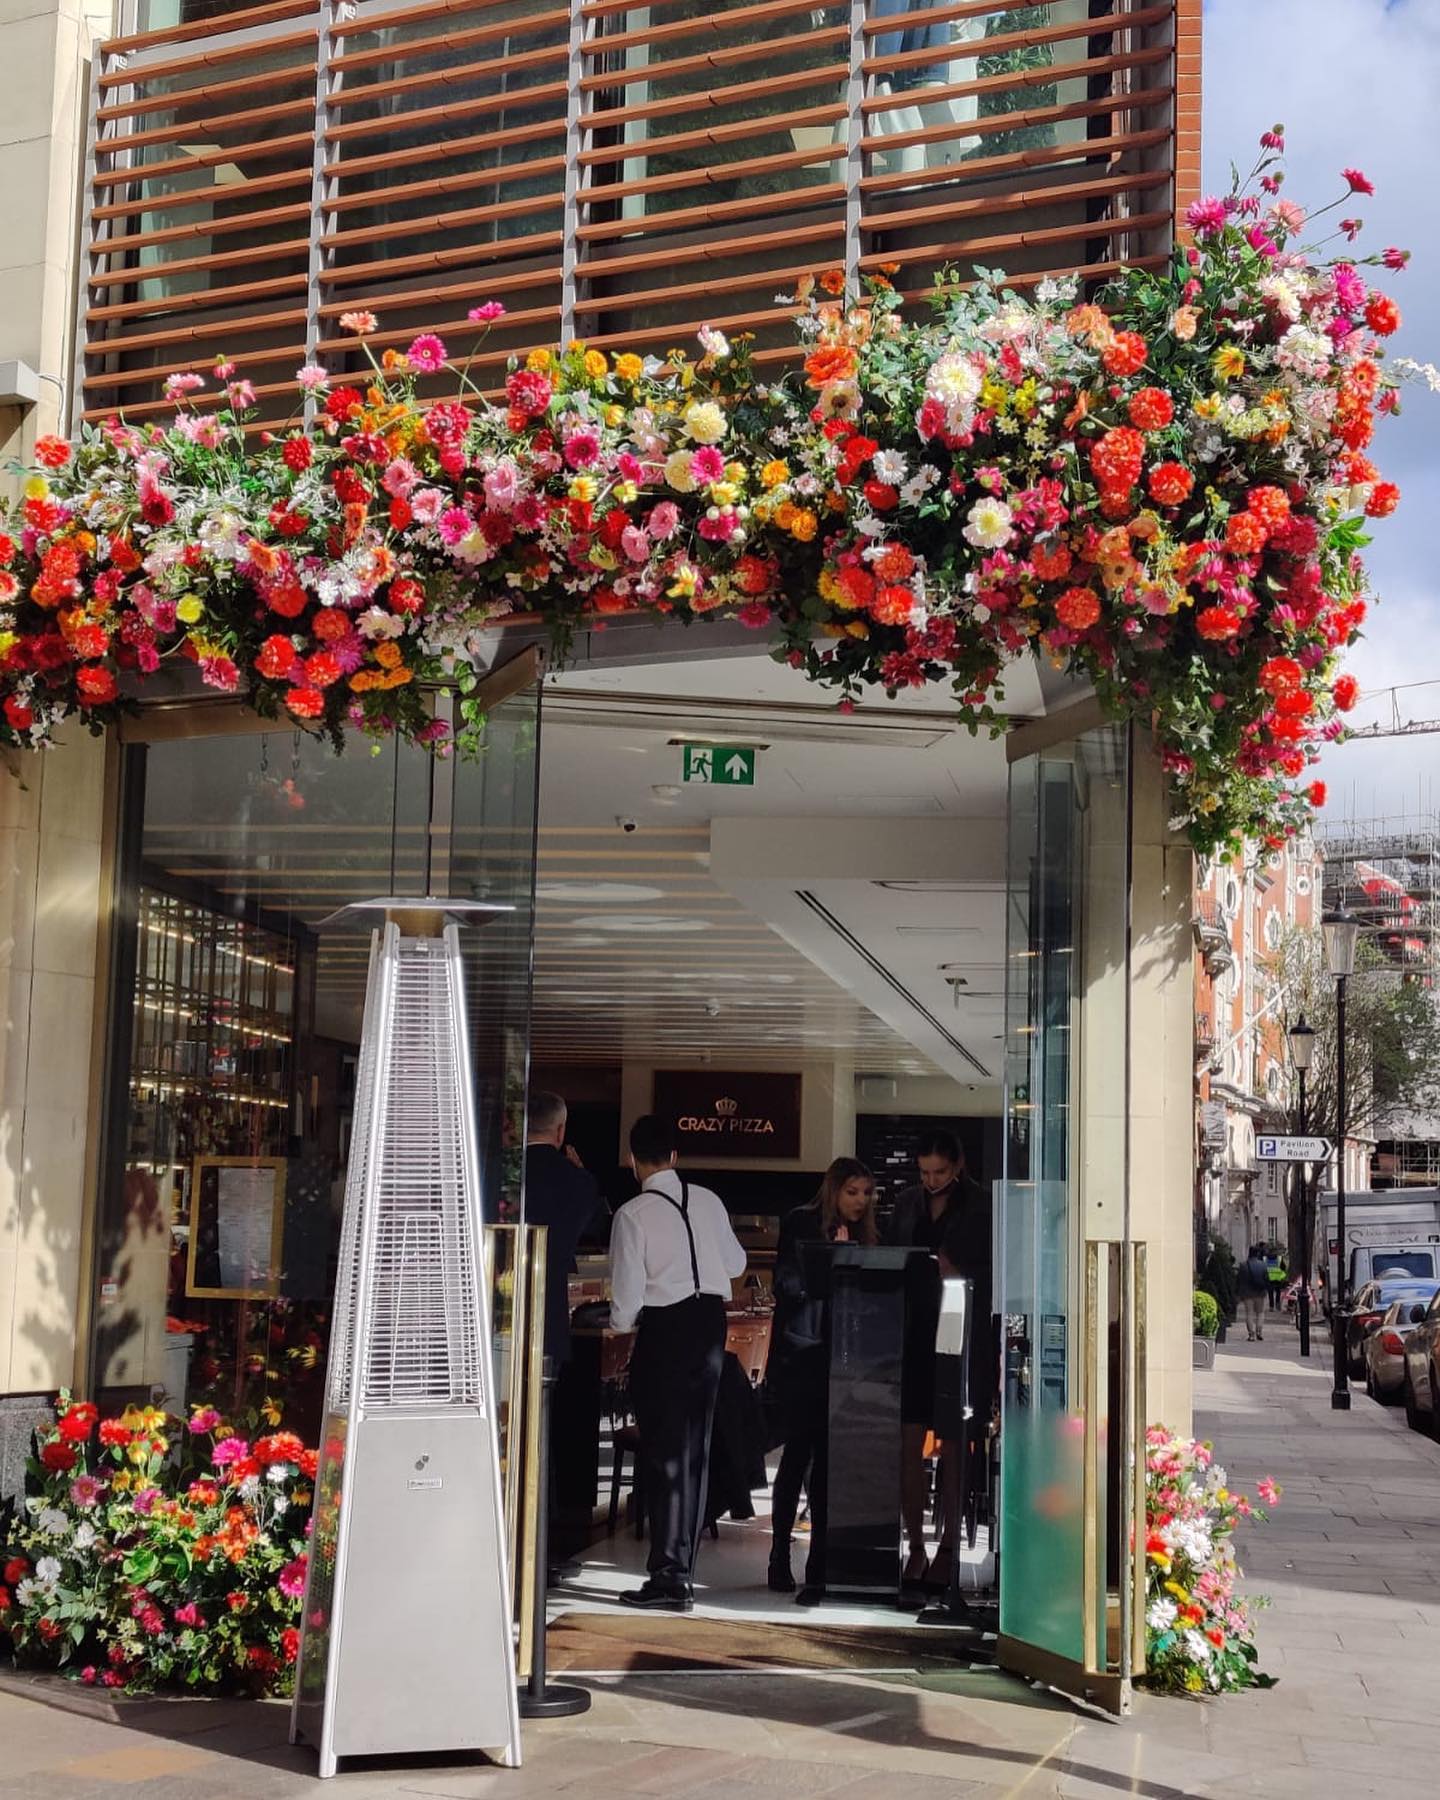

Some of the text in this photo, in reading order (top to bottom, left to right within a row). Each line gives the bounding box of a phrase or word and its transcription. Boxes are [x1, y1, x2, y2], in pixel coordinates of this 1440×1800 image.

[678, 1117, 774, 1132] CRAZY PIZZA
[1262, 1141, 1274, 1155] P
[1280, 1140, 1315, 1148] Pavilion
